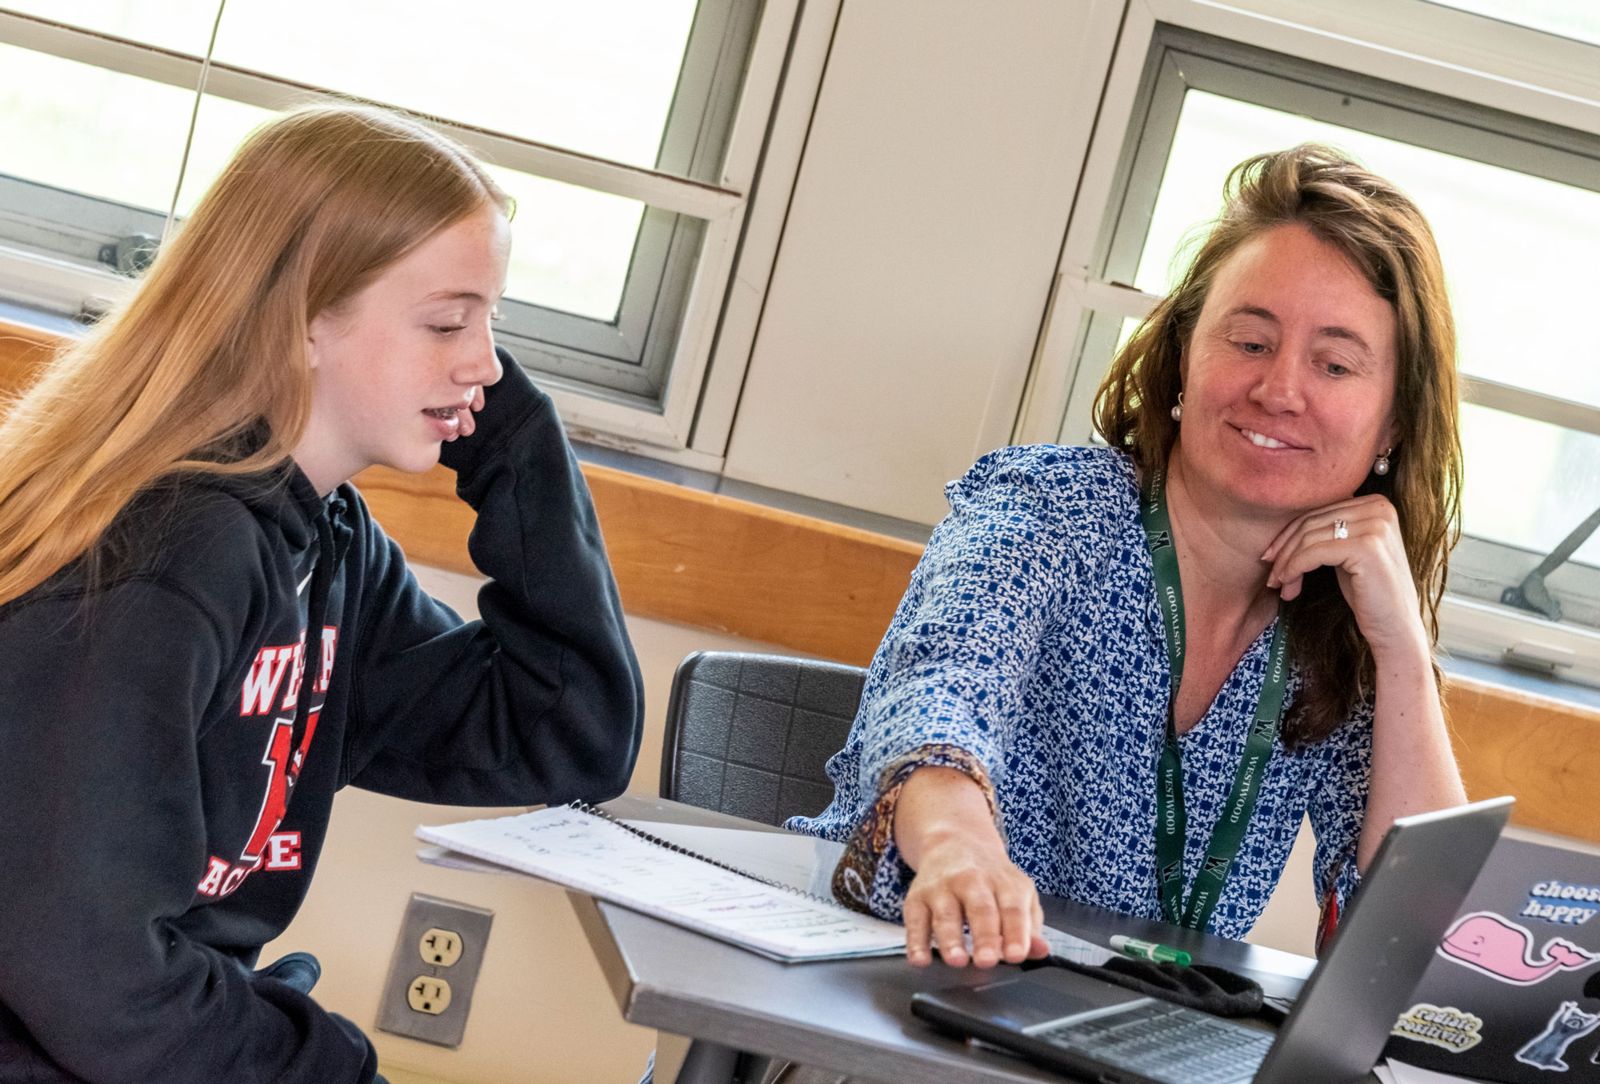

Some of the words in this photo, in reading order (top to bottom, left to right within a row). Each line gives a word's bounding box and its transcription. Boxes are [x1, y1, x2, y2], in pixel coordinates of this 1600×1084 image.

[1166, 586, 1182, 658] WESTWOOD
[1165, 768, 1176, 835] WESTWOOD
[1230, 756, 1260, 824] WESTWOOD
[1520, 900, 1598, 925] happy
[1530, 881, 1600, 902] choos
[1413, 1008, 1478, 1032] radiate
